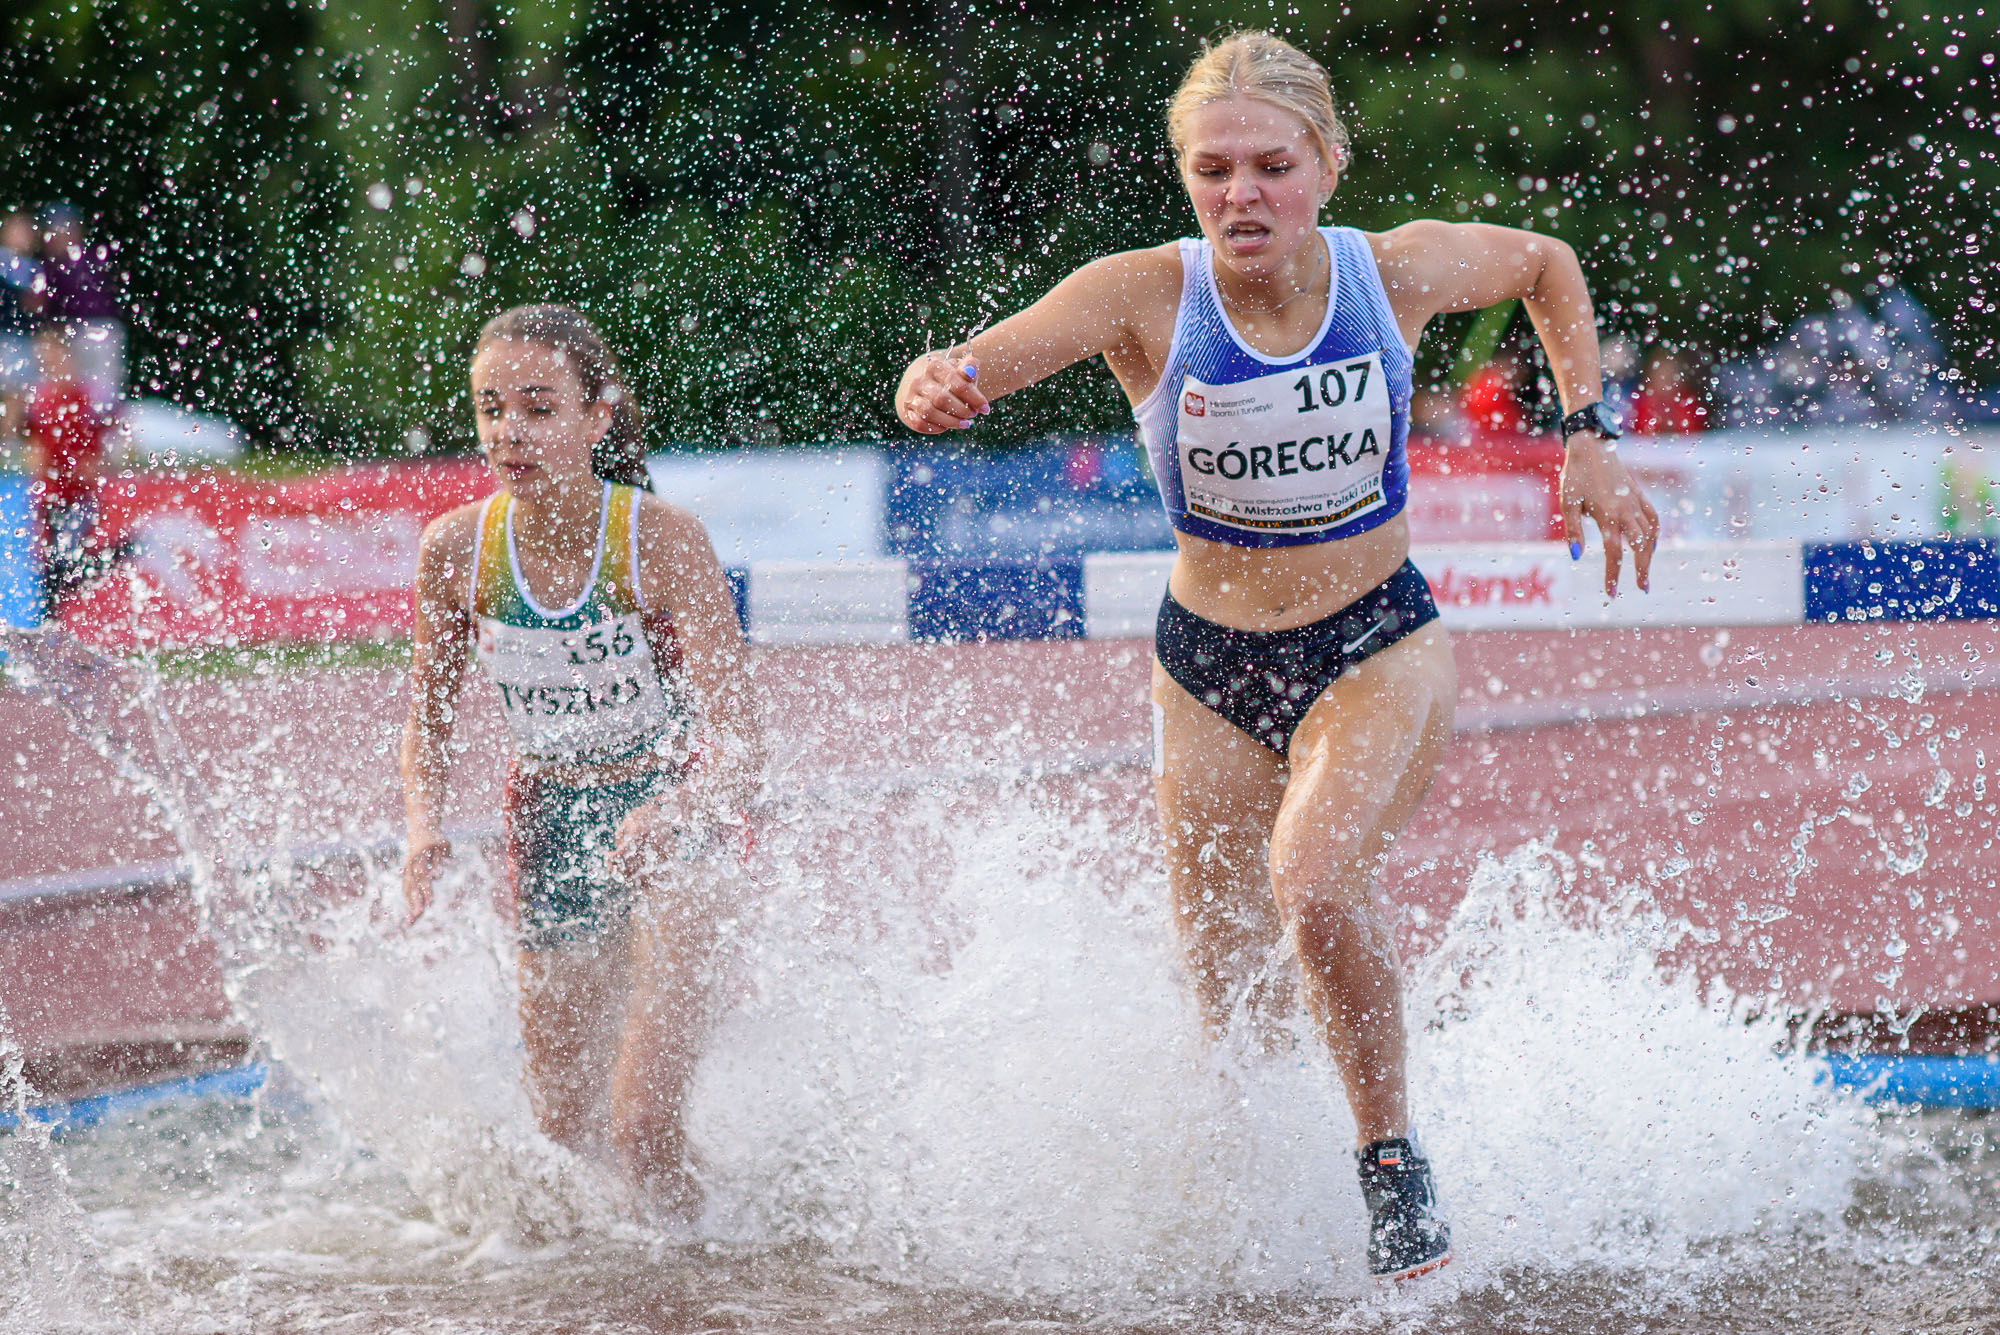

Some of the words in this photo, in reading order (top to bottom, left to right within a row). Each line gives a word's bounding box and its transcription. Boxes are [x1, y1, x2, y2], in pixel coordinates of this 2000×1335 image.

[1294, 361, 1371, 413] 107
[1210, 409, 1235, 418] Sportu
[1188, 428, 1380, 480] GÓRECKA
[1244, 502, 1322, 516] Mistrzostwa
[1327, 487, 1358, 509] Polski
[1361, 476, 1379, 495] U18
[562, 623, 634, 665] 156
